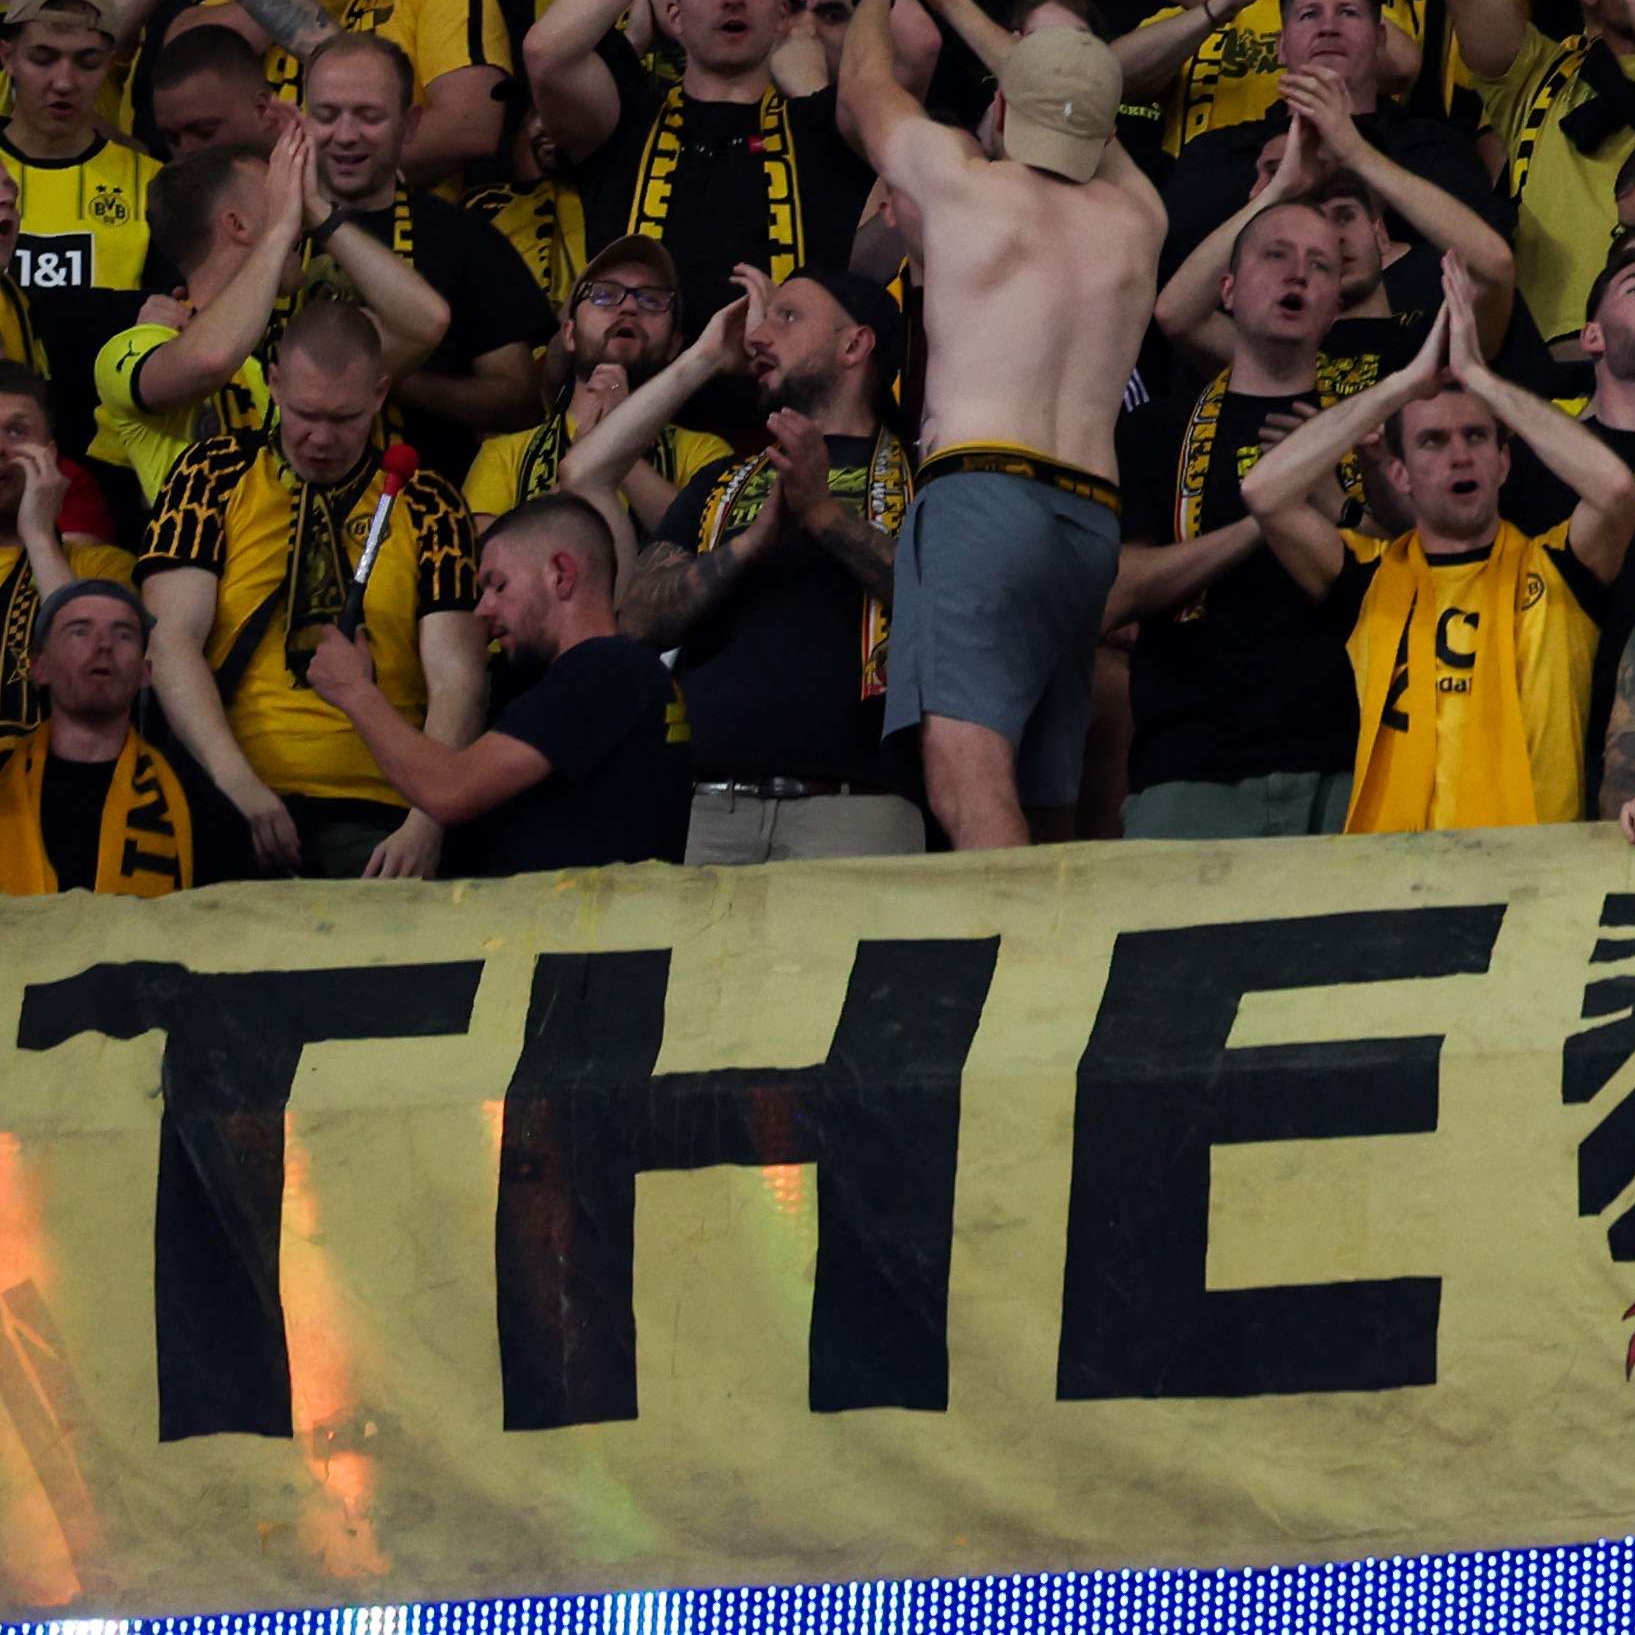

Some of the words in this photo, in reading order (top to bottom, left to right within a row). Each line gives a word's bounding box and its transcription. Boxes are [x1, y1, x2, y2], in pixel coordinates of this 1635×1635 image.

[94, 197, 126, 219] BVB
[16, 248, 84, 289] 1&1
[14, 900, 1511, 1445] THE
